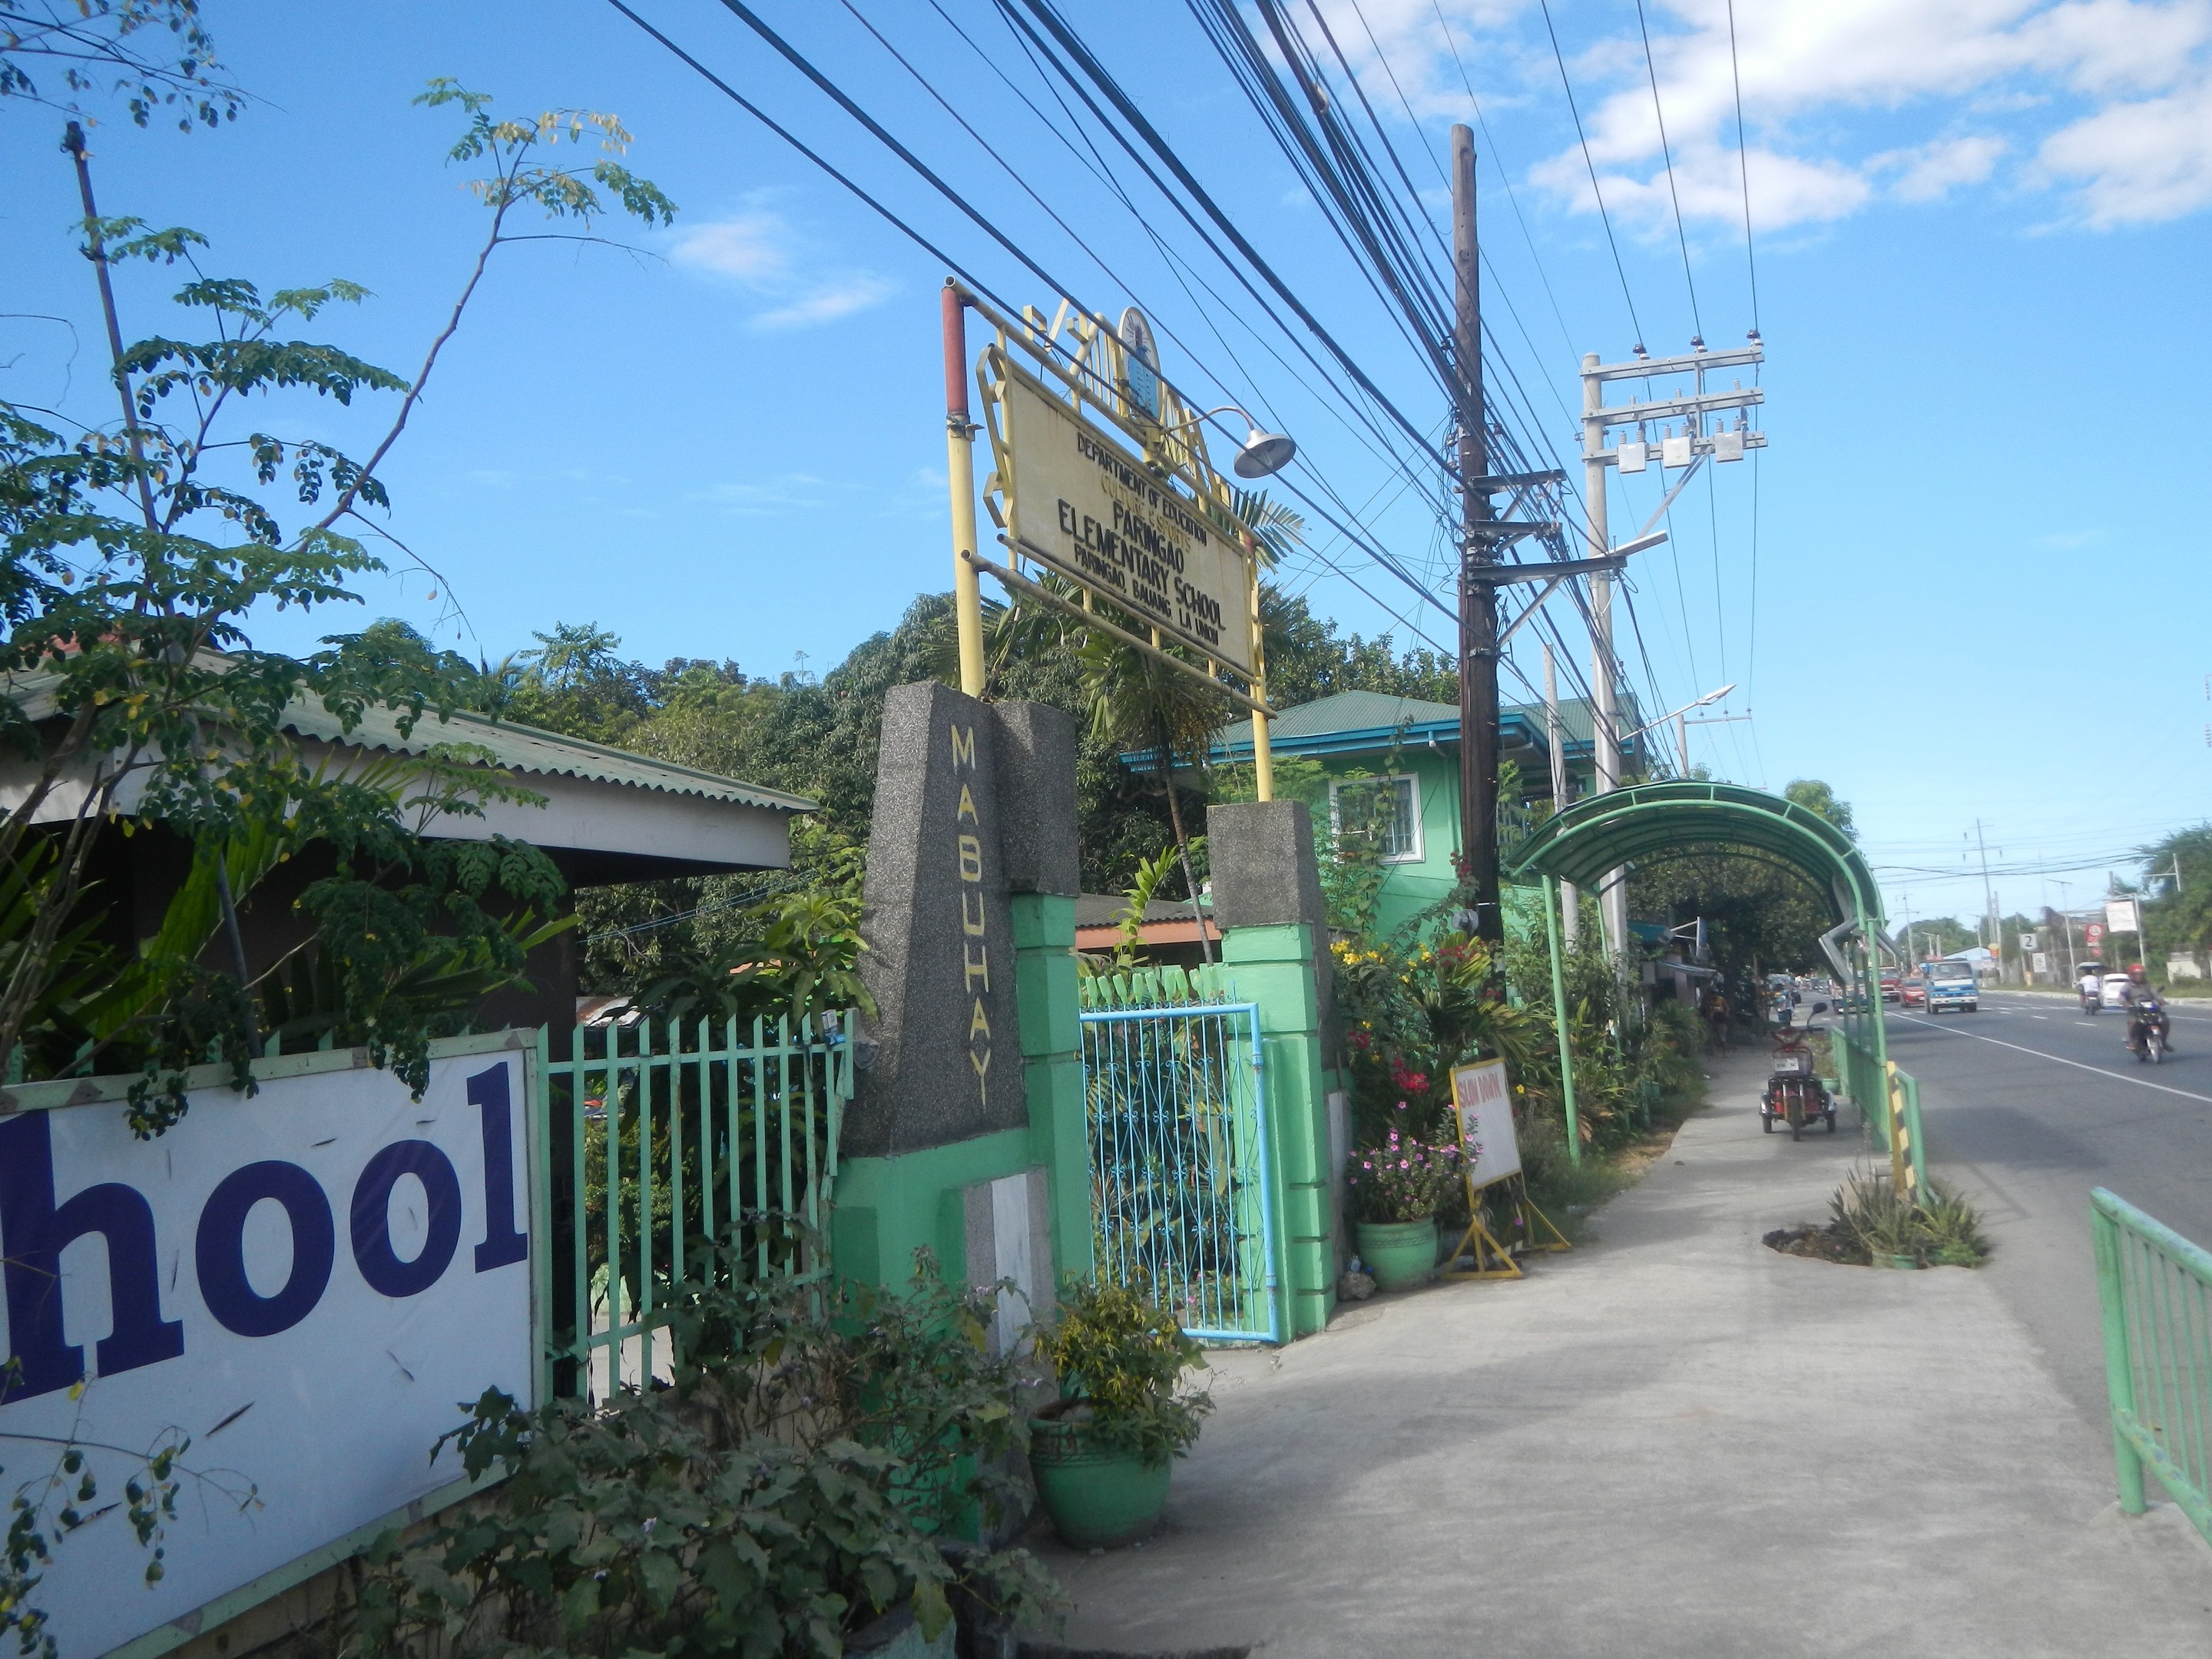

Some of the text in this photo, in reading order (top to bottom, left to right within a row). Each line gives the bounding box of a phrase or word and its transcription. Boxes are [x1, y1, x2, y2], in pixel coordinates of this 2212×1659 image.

[1078, 432, 1207, 547] DEPARTMENT OF EDUCATION
[1113, 500, 1184, 575] PARINGAO
[1058, 498, 1227, 631] ELEMENTARY SCHOOL
[1075, 543, 1127, 594] PARINGAO,
[1179, 608, 1192, 631] LA
[1195, 618, 1219, 646] UNION
[950, 724, 992, 1109] MABUHAY
[0, 1061, 528, 1406] hool
